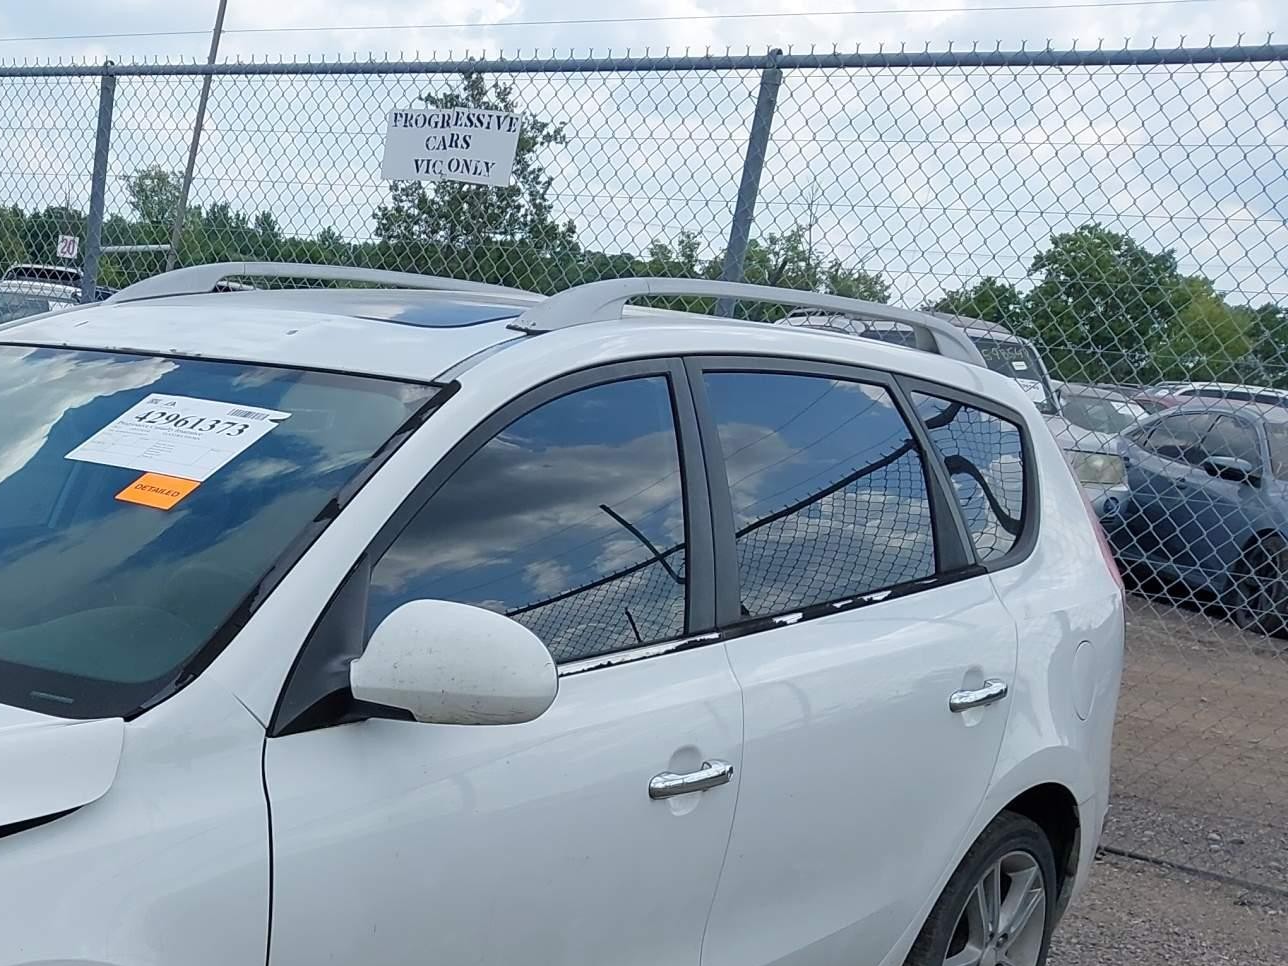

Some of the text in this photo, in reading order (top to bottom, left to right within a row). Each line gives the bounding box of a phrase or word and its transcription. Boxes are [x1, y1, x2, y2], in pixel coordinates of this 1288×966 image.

[392, 110, 519, 133] PROGRESSIVE
[425, 132, 472, 151] CARS
[414, 157, 496, 178] VIC ONLY
[60, 238, 76, 256] 20
[134, 410, 250, 437] 42961373
[134, 483, 181, 498] DETAILED
